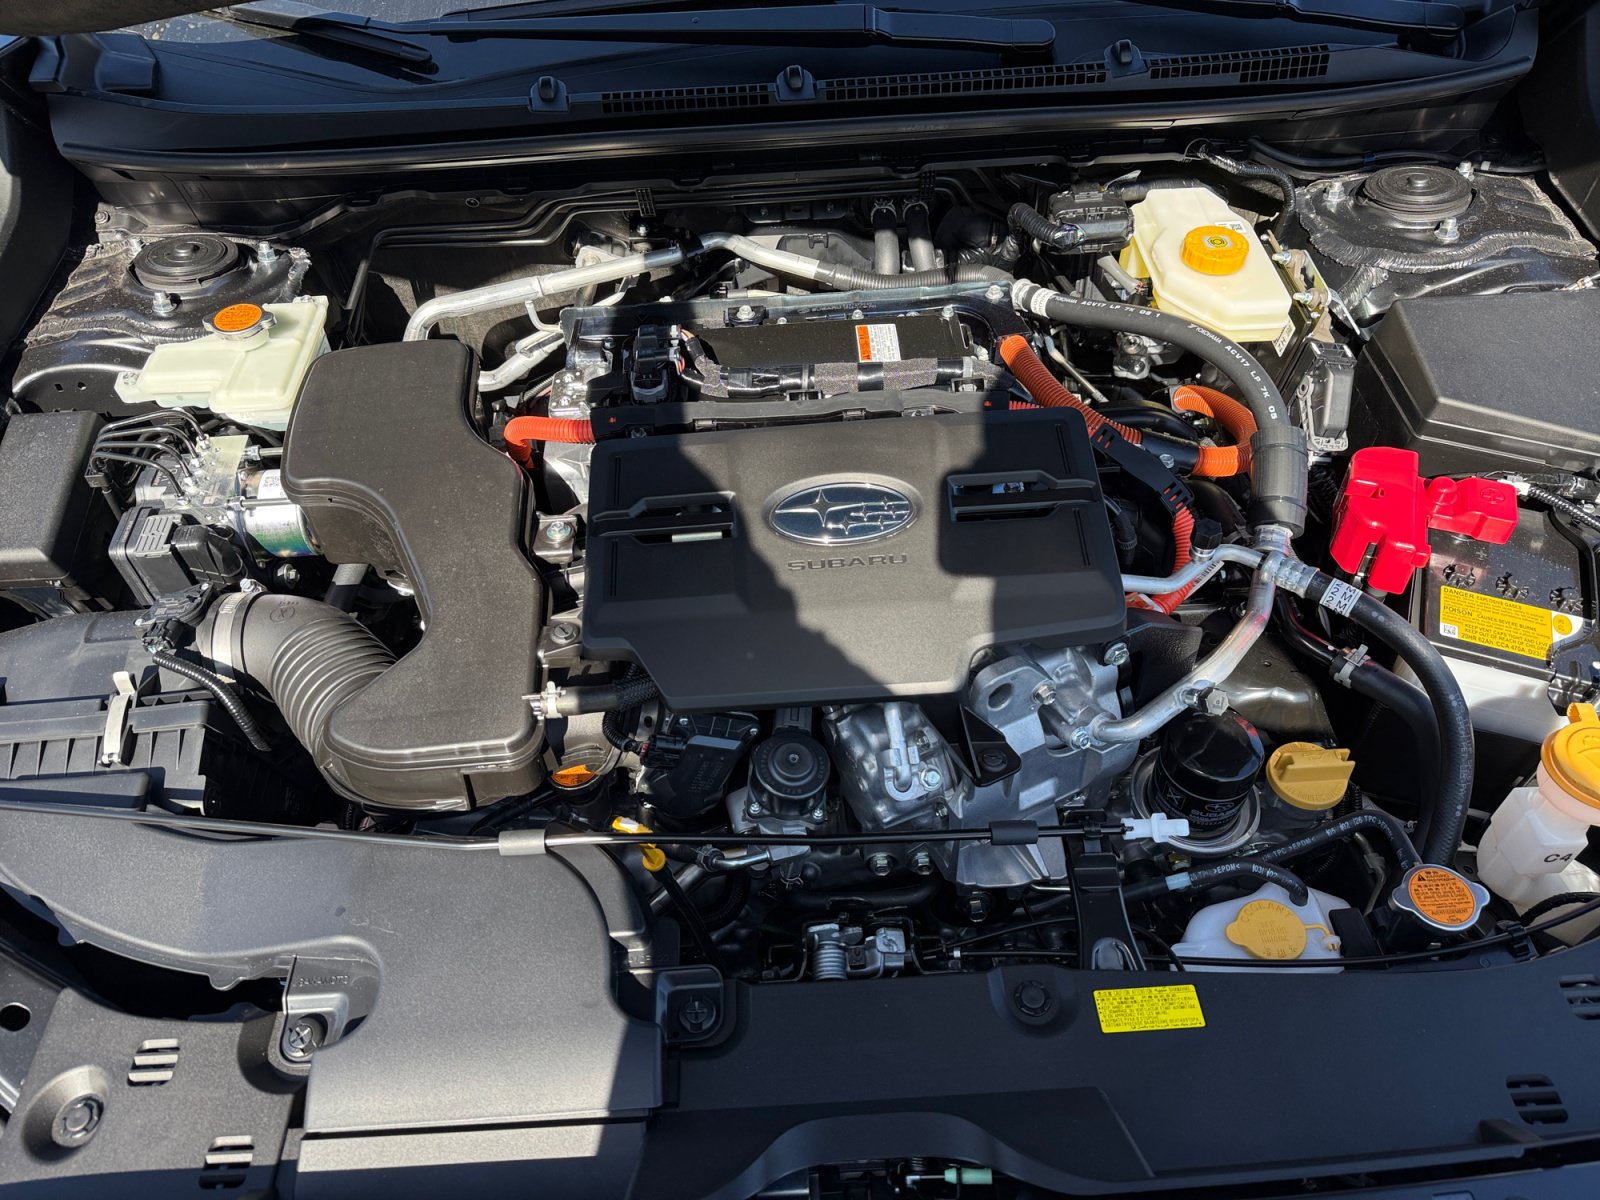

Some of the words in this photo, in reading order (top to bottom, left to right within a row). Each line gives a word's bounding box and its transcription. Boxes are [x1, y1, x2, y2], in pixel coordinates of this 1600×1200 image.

[1196, 327, 1222, 344] YOKOHAMA
[1225, 345, 1250, 367] ACV17
[1250, 370, 1261, 382] LP
[1260, 385, 1270, 399] 7K
[787, 552, 908, 571] SUBARU
[1443, 587, 1474, 598] DANGER
[1443, 605, 1473, 617] POISON
[1496, 641, 1510, 649] CCA
[1272, 847, 1287, 857] TPC
[1363, 814, 1377, 823] TPC
[1543, 853, 1573, 863] C4
[1213, 862, 1241, 875] >EPDM<
